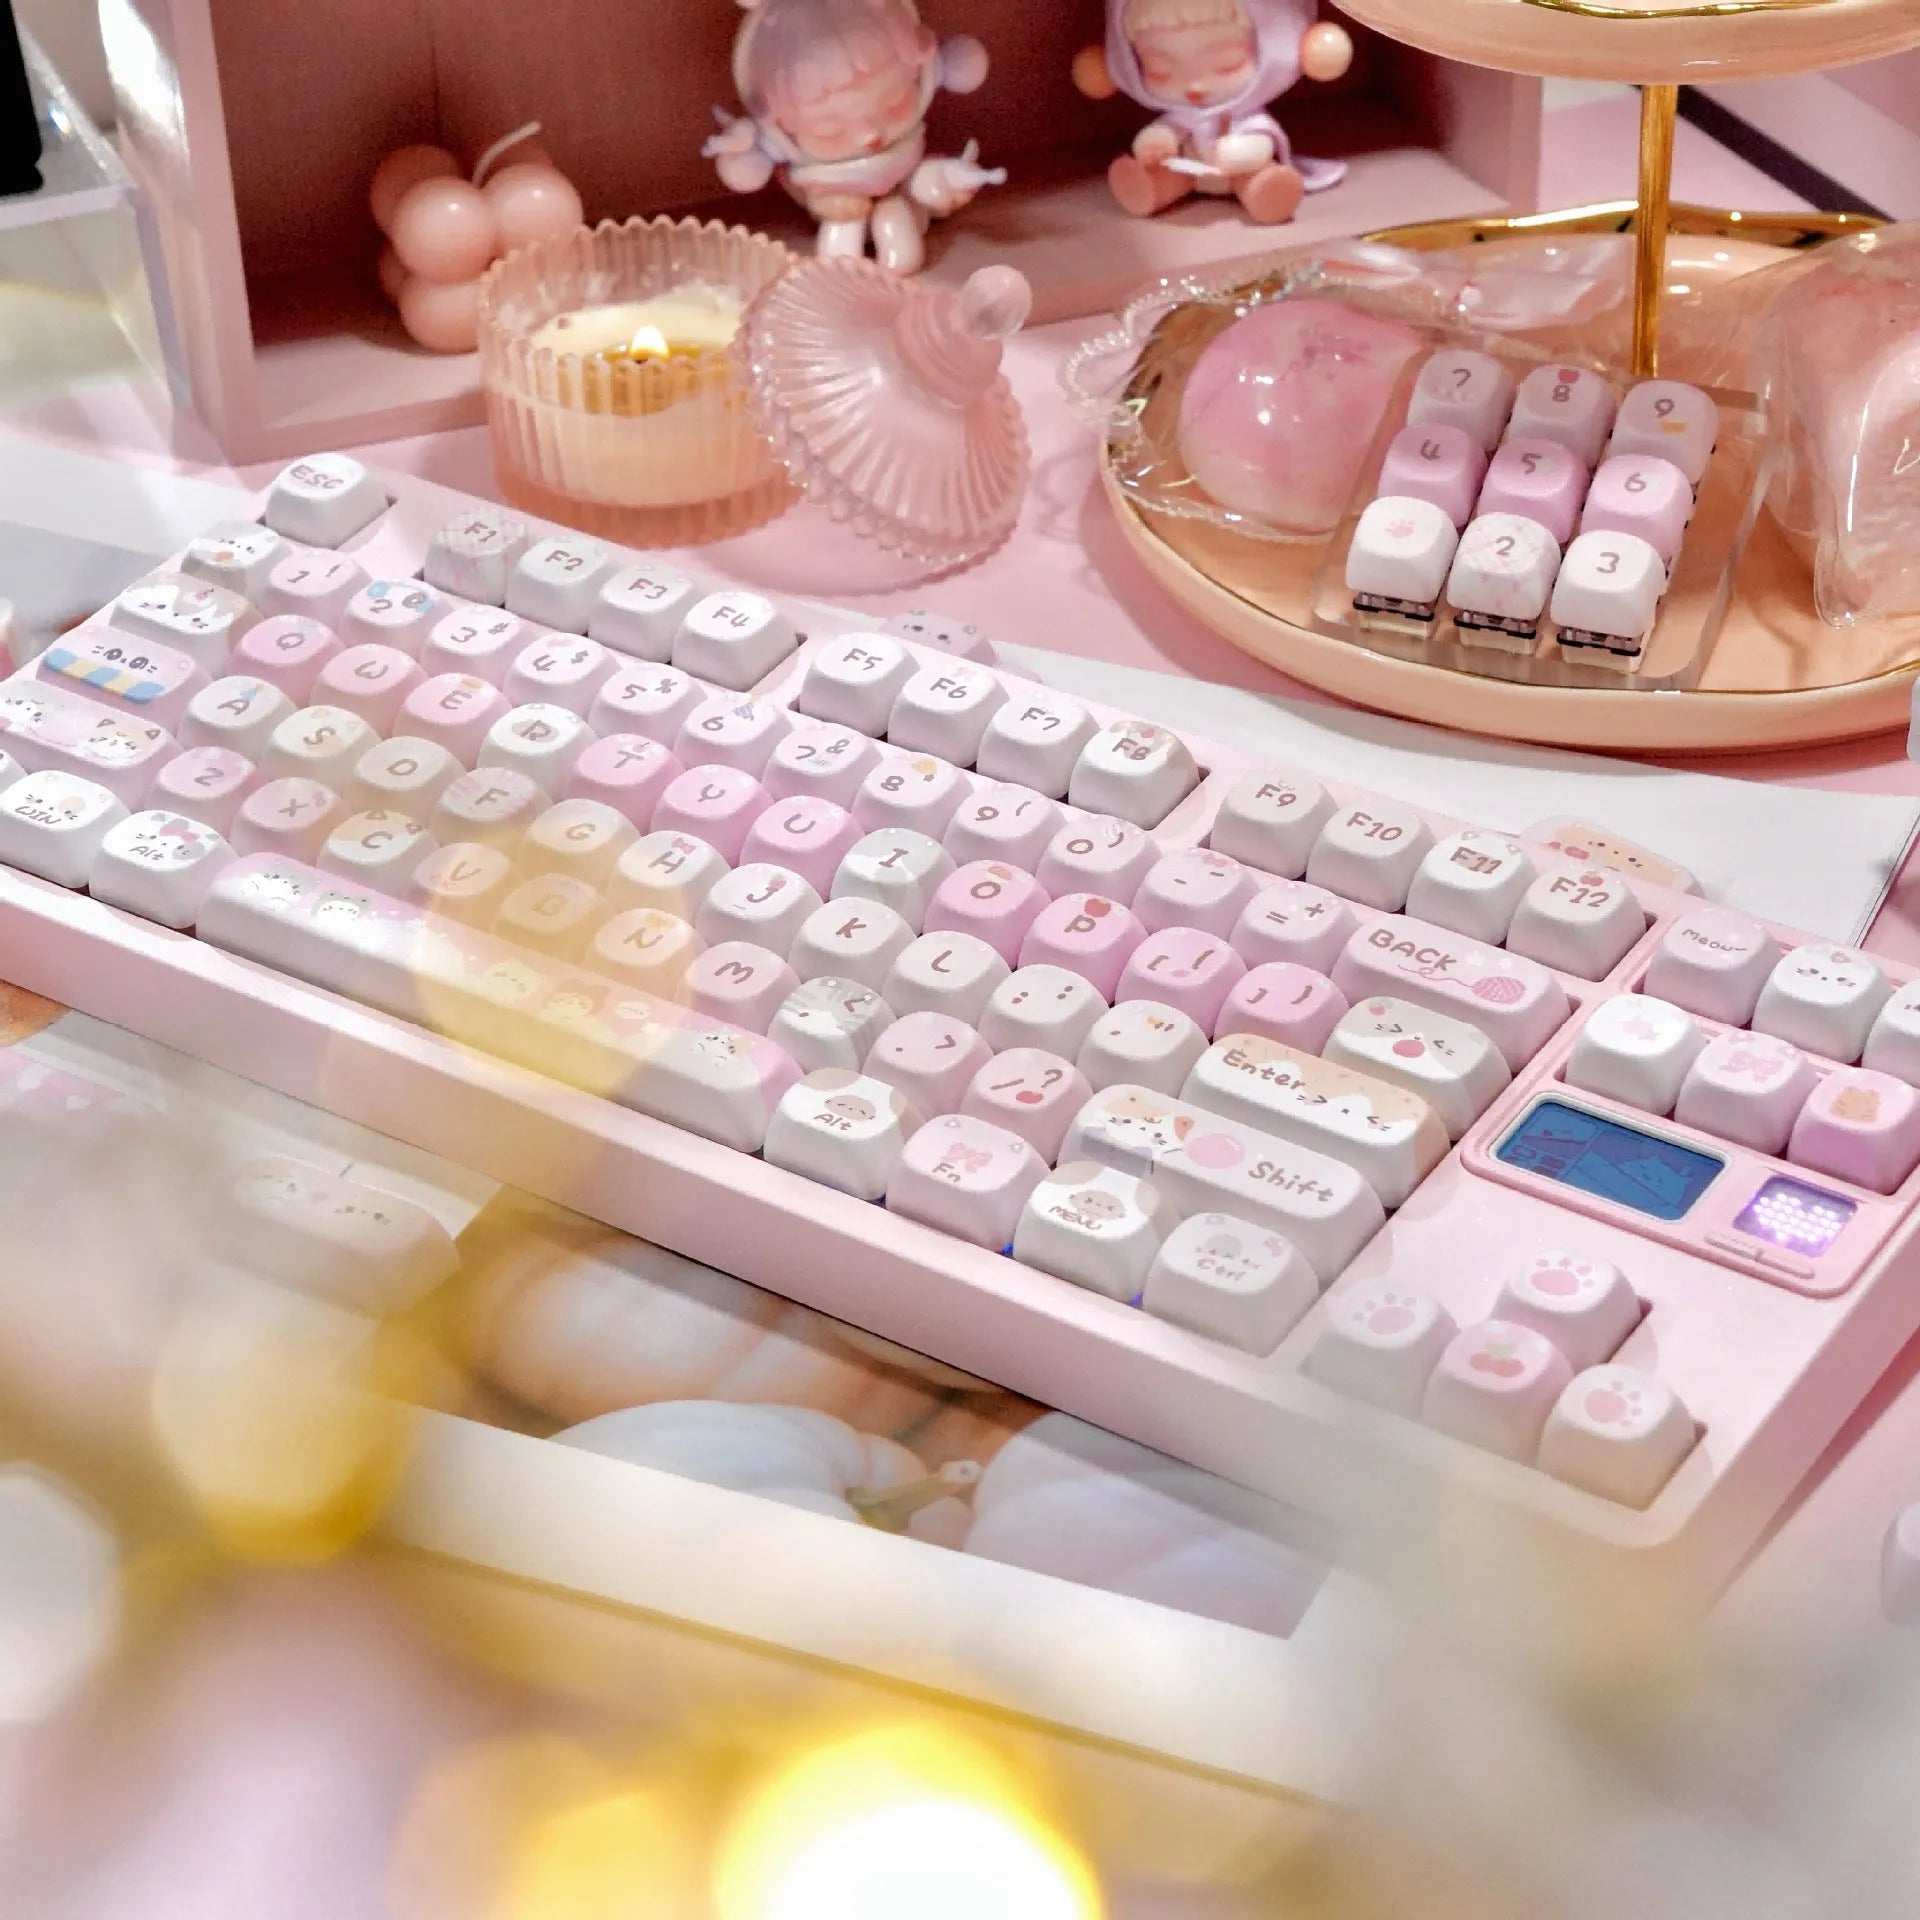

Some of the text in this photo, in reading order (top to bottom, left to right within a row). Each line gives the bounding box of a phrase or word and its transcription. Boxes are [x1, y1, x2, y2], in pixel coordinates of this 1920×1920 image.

[1451, 368, 1472, 388] 7
[1552, 384, 1571, 403] 8
[1654, 398, 1675, 418] 9
[1420, 439, 1441, 460] 4
[1521, 453, 1542, 475] 5
[1624, 472, 1647, 492] 6
[464, 521, 497, 542] F1
[1495, 536, 1516, 556] 2
[545, 549, 584, 571] F2
[1596, 551, 1620, 574] 3
[288, 570, 310, 584] 1
[628, 578, 668, 600] F3
[368, 599, 393, 614] 2
[712, 606, 750, 627] F4
[276, 632, 305, 651] Q
[451, 626, 478, 643] 3
[532, 653, 557, 672] 4
[842, 647, 883, 671] F5
[621, 683, 647, 700] 5
[930, 677, 967, 699] F6
[217, 699, 250, 715] A
[439, 689, 473, 711] E
[701, 716, 725, 732] 6
[1020, 706, 1061, 731] F7
[303, 726, 336, 746] S
[520, 720, 551, 741] R
[614, 749, 645, 768] T
[794, 744, 817, 760] 7
[1111, 737, 1151, 761] F8
[193, 767, 225, 786] Z
[386, 758, 419, 776] D
[697, 783, 726, 803] Y
[881, 775, 905, 791] 8
[475, 787, 509, 805] F
[1255, 783, 1297, 807] F9
[14, 804, 62, 825] WIN
[278, 798, 309, 817] X
[974, 806, 999, 822] 9
[565, 823, 597, 841] G
[783, 813, 816, 834] U
[1347, 812, 1403, 841] F10
[361, 831, 393, 849] C
[129, 845, 165, 861] Alt
[648, 850, 687, 874] H
[879, 847, 909, 868] I
[1450, 846, 1503, 875] F11
[746, 884, 780, 903] J
[970, 881, 1001, 899] O
[1549, 876, 1610, 908] F12
[835, 917, 867, 938] K
[1064, 915, 1097, 934] P
[622, 927, 664, 950] N
[1368, 928, 1458, 972] BACK
[931, 950, 953, 974] L
[714, 961, 754, 984] M
[1041, 1067, 1064, 1089] ?
[1222, 1047, 1306, 1090] Enter
[812, 1113, 852, 1132] Alt
[931, 1162, 962, 1183] Fn
[1248, 1160, 1335, 1203] Shift
